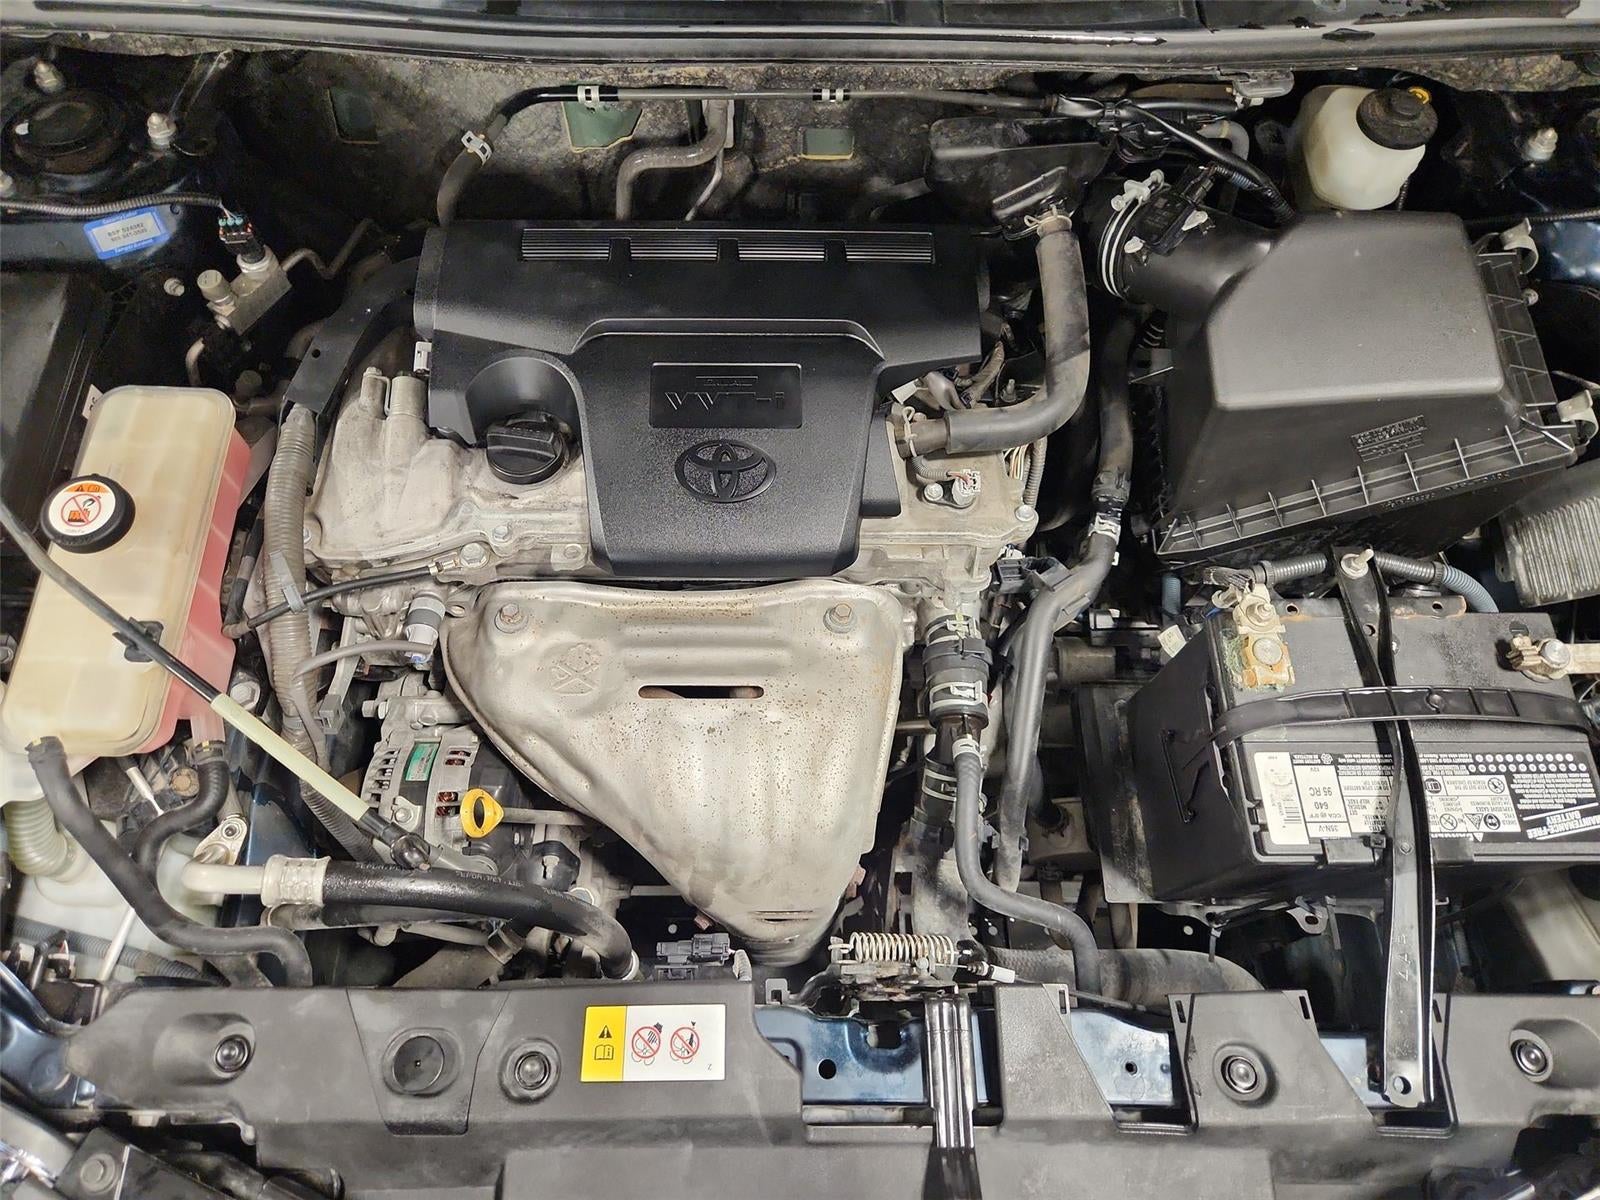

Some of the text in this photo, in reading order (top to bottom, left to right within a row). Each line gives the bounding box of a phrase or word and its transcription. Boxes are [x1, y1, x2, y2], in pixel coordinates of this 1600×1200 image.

[1309, 787, 1332, 796] 95 RC
[1314, 801, 1329, 809] 640
[1545, 810, 1581, 825] BATTERY
[1526, 814, 1600, 839] MAINTENANCE-FREE
